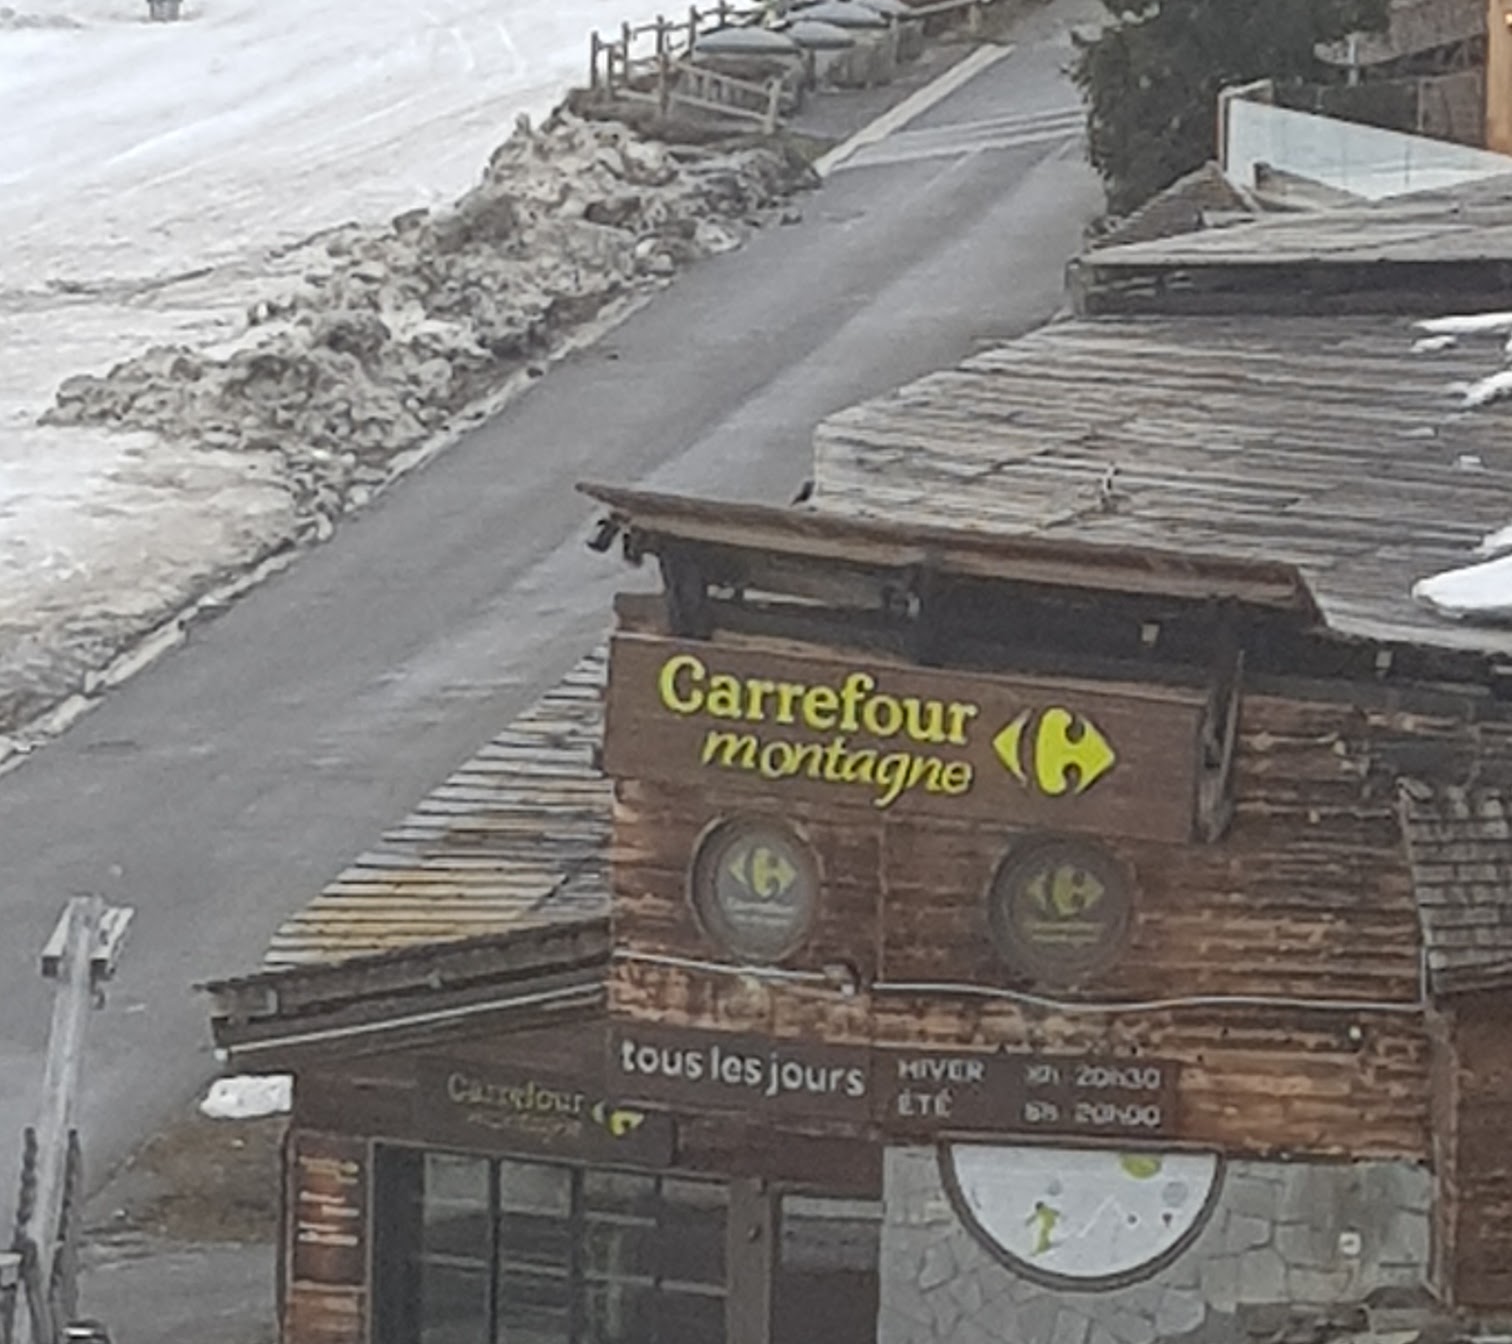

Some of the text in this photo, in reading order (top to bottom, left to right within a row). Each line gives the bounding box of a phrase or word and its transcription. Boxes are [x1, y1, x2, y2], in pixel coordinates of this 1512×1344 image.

[658, 654, 977, 745] Carrefour
[702, 730, 974, 807] montagne
[621, 1039, 866, 1096] tous les jours
[898, 1058, 985, 1083] HIVER
